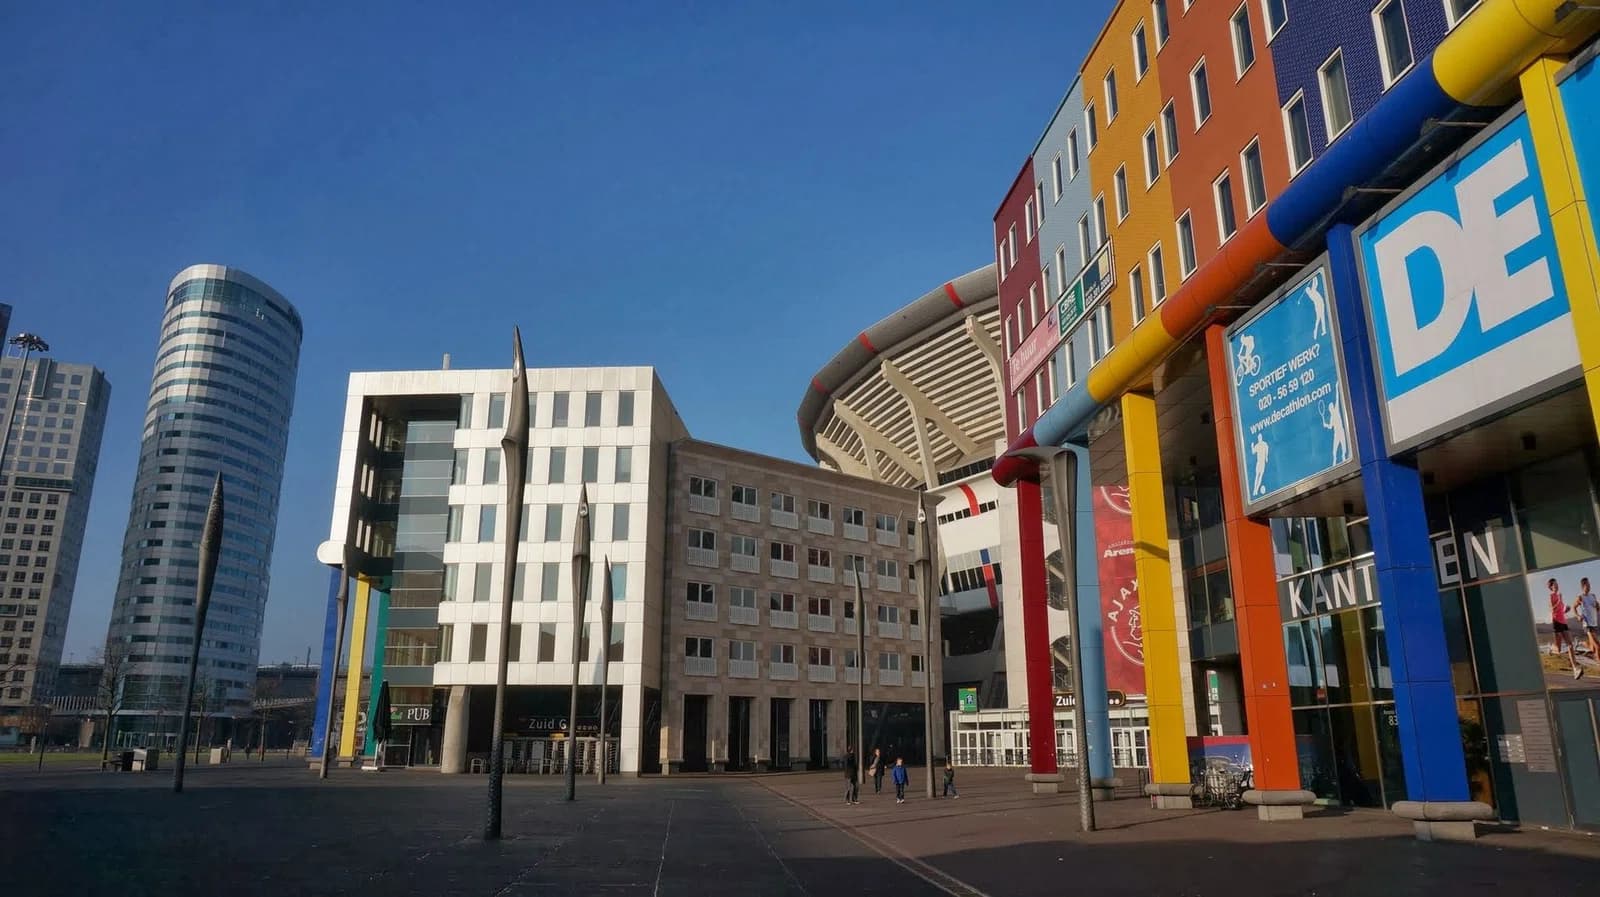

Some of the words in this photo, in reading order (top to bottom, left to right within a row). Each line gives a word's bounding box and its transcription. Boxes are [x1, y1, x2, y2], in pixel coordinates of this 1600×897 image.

[1374, 138, 1555, 377] DE
[1249, 363, 1287, 397] SPORTIEF
[1288, 343, 1320, 372] WERK?
[1258, 393, 1272, 411] 020
[1277, 384, 1288, 400] 56
[1288, 378, 1299, 393] 59
[1300, 368, 1315, 385] 120
[1250, 382, 1331, 434] www.decathlon.com
[1103, 547, 1136, 558] Aren
[1288, 527, 1500, 619] KANTEN
[1107, 578, 1138, 622] AJAX
[407, 707, 430, 721] PUB
[528, 718, 555, 730] Zuid
